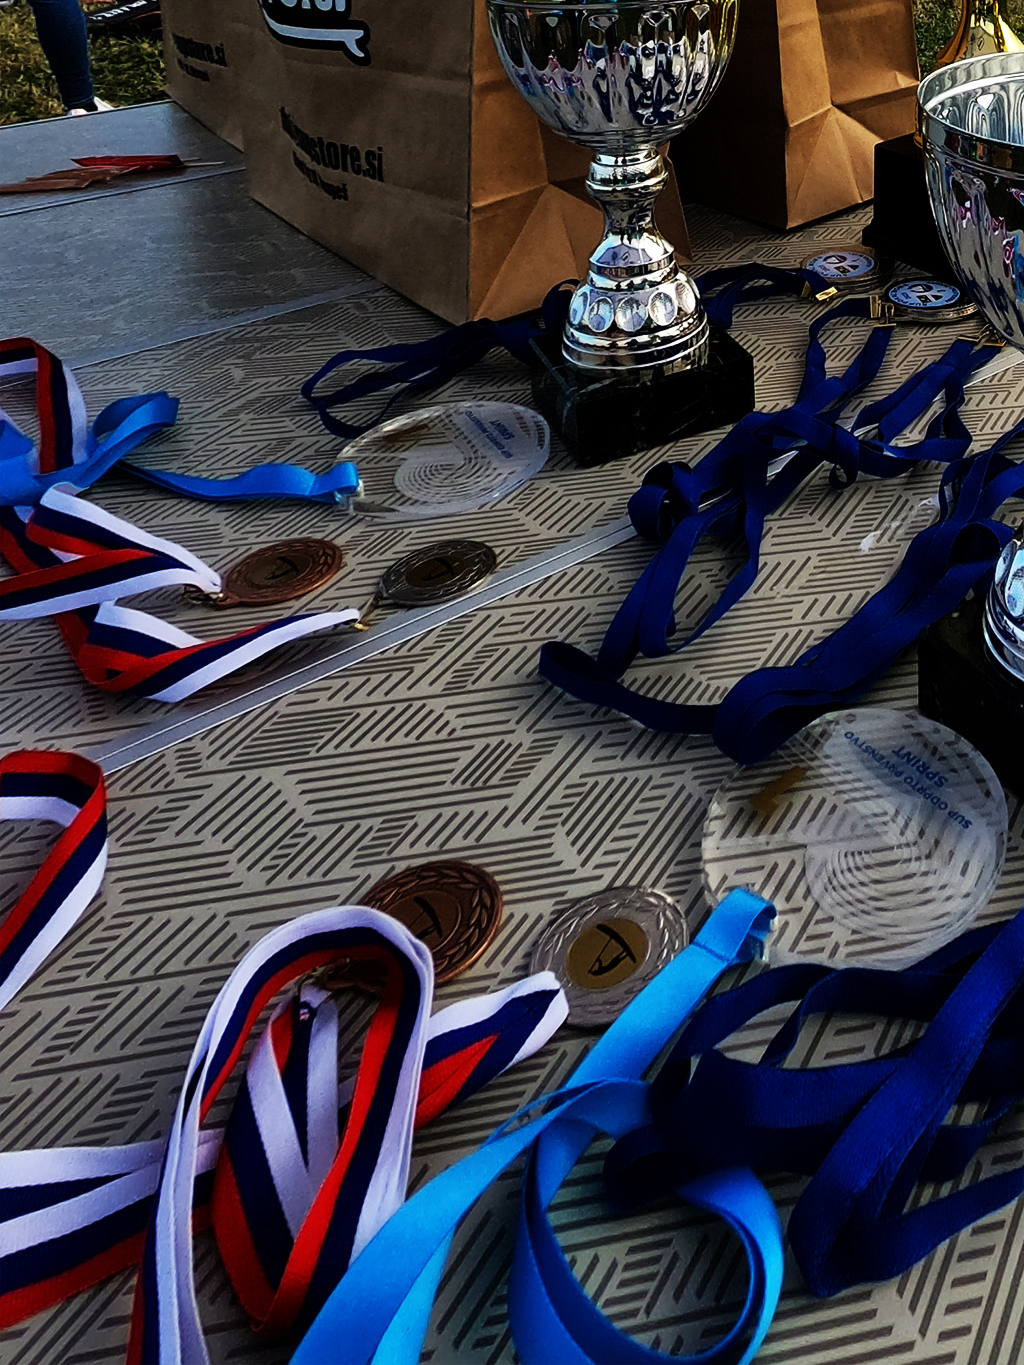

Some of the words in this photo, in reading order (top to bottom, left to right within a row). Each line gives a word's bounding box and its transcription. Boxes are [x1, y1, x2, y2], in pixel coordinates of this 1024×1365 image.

[892, 745, 948, 787] SPRINT
[903, 775, 948, 812] ODPRTO
[948, 810, 972, 830] SUP
